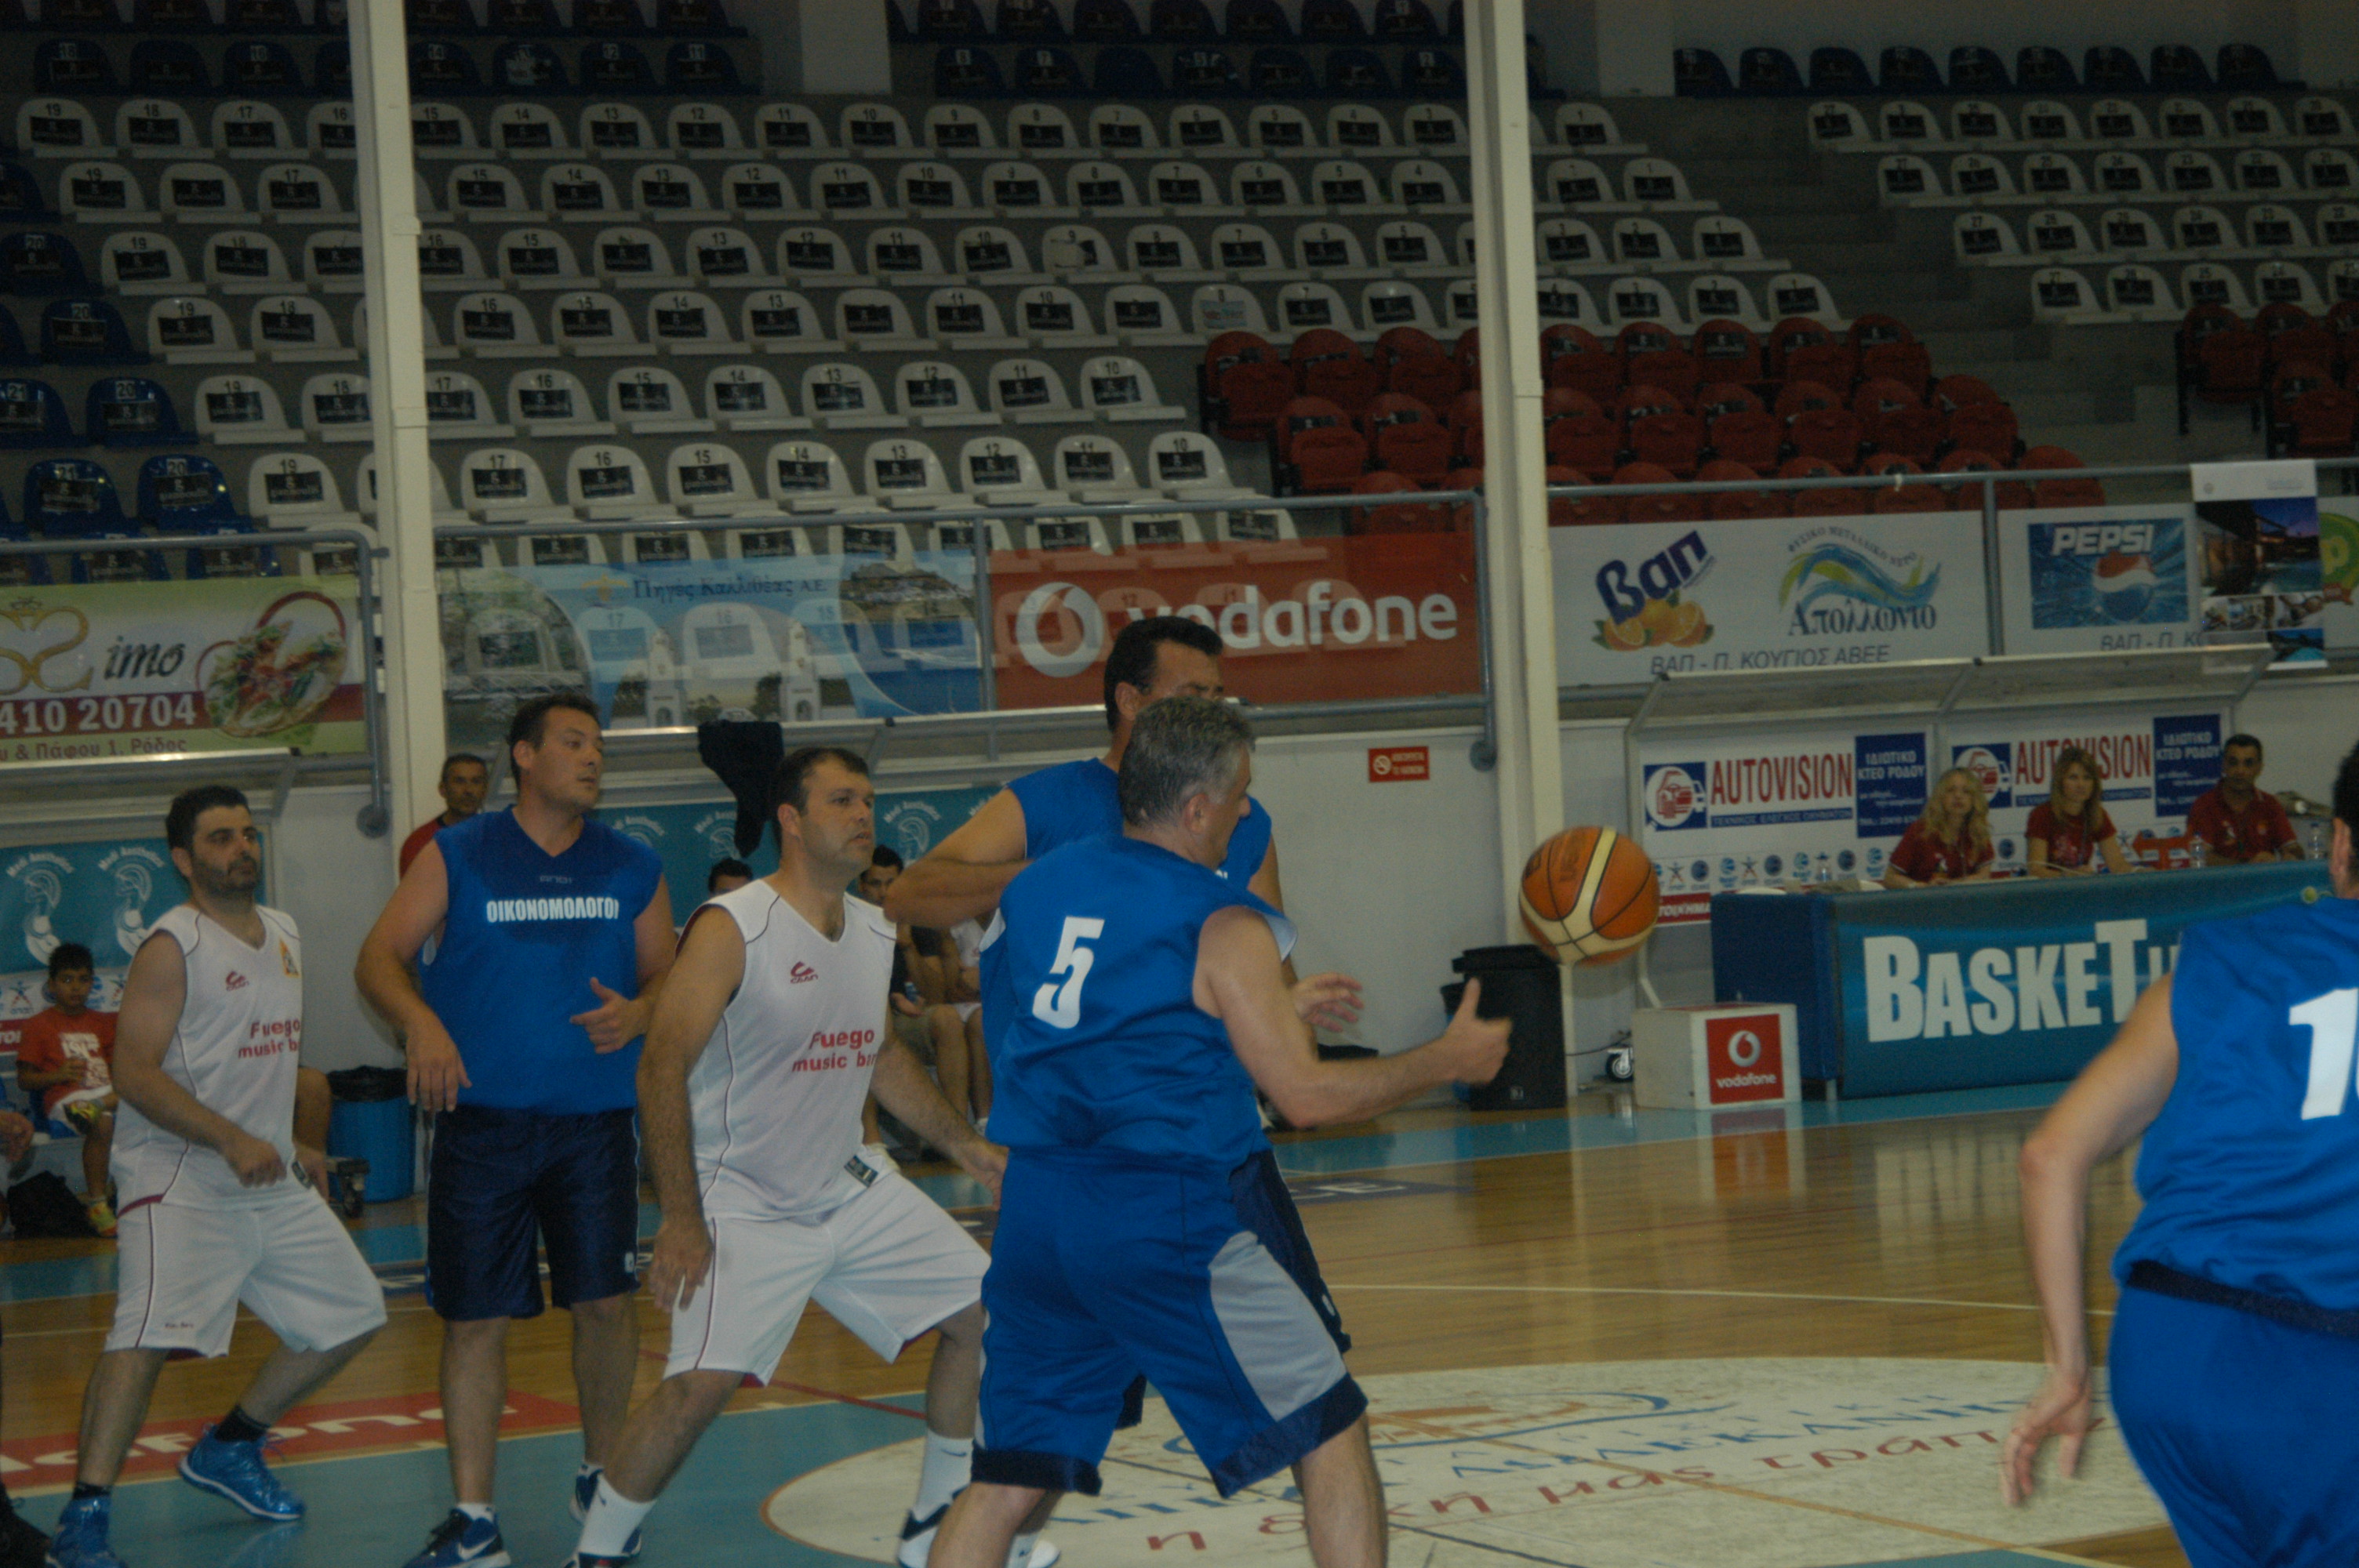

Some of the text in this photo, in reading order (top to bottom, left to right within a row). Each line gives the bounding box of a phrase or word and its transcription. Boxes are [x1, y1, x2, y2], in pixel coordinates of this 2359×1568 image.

[45, 104, 61, 117] 19
[144, 103, 160, 117] 18
[238, 106, 253, 118] 17
[332, 107, 347, 120] 16
[423, 107, 439, 121] 15
[514, 107, 529, 121] 14
[605, 107, 620, 120] 13
[690, 107, 705, 121] 12
[776, 107, 791, 121] 11
[85, 168, 102, 181] 19
[284, 169, 300, 183] 17
[471, 169, 487, 181] 15
[567, 169, 583, 182] 14
[655, 169, 671, 182] 13
[745, 167, 761, 180] 12
[834, 168, 848, 181] 11
[178, 302, 195, 316] 19
[279, 300, 296, 314] 18
[729, 368, 746, 383] 14
[826, 368, 842, 383] 13
[923, 366, 939, 380] 12
[1013, 365, 1028, 378] 11
[1104, 361, 1121, 376] 10
[434, 376, 452, 391] 17
[536, 373, 553, 389] 16
[634, 371, 651, 385] 15
[6, 383, 27, 401] 21
[116, 382, 136, 398] 20
[224, 379, 242, 394] 19
[332, 379, 350, 394] 18
[890, 445, 907, 459] 13
[984, 442, 1001, 457] 12
[1079, 441, 1095, 453] 11
[1172, 437, 1189, 452] 10
[488, 454, 506, 469] 17
[594, 451, 612, 466] 16
[694, 448, 711, 464] 15
[793, 447, 809, 462] 14
[58, 464, 78, 481] 21
[166, 459, 186, 476] 20
[279, 459, 297, 474] 19
[2052, 523, 2155, 557] PEPSI
[1127, 582, 1458, 651] dafone
[1650, 655, 1695, 676] ΒΑΠ
[1834, 645, 1891, 666] ΑΒΕΕ
[78, 693, 197, 731] 20704
[1710, 753, 1853, 805] AUTOVISION
[485, 896, 620, 924] ΟΙΚΟΝΟΜΟΛΟΓΟΙ
[1031, 915, 1106, 1030] 5
[249, 1018, 301, 1040] Fuego
[809, 1029, 875, 1050] Fuego
[238, 1040, 284, 1060] music
[791, 1053, 848, 1073] music
[1715, 1072, 1777, 1090] vodafone
